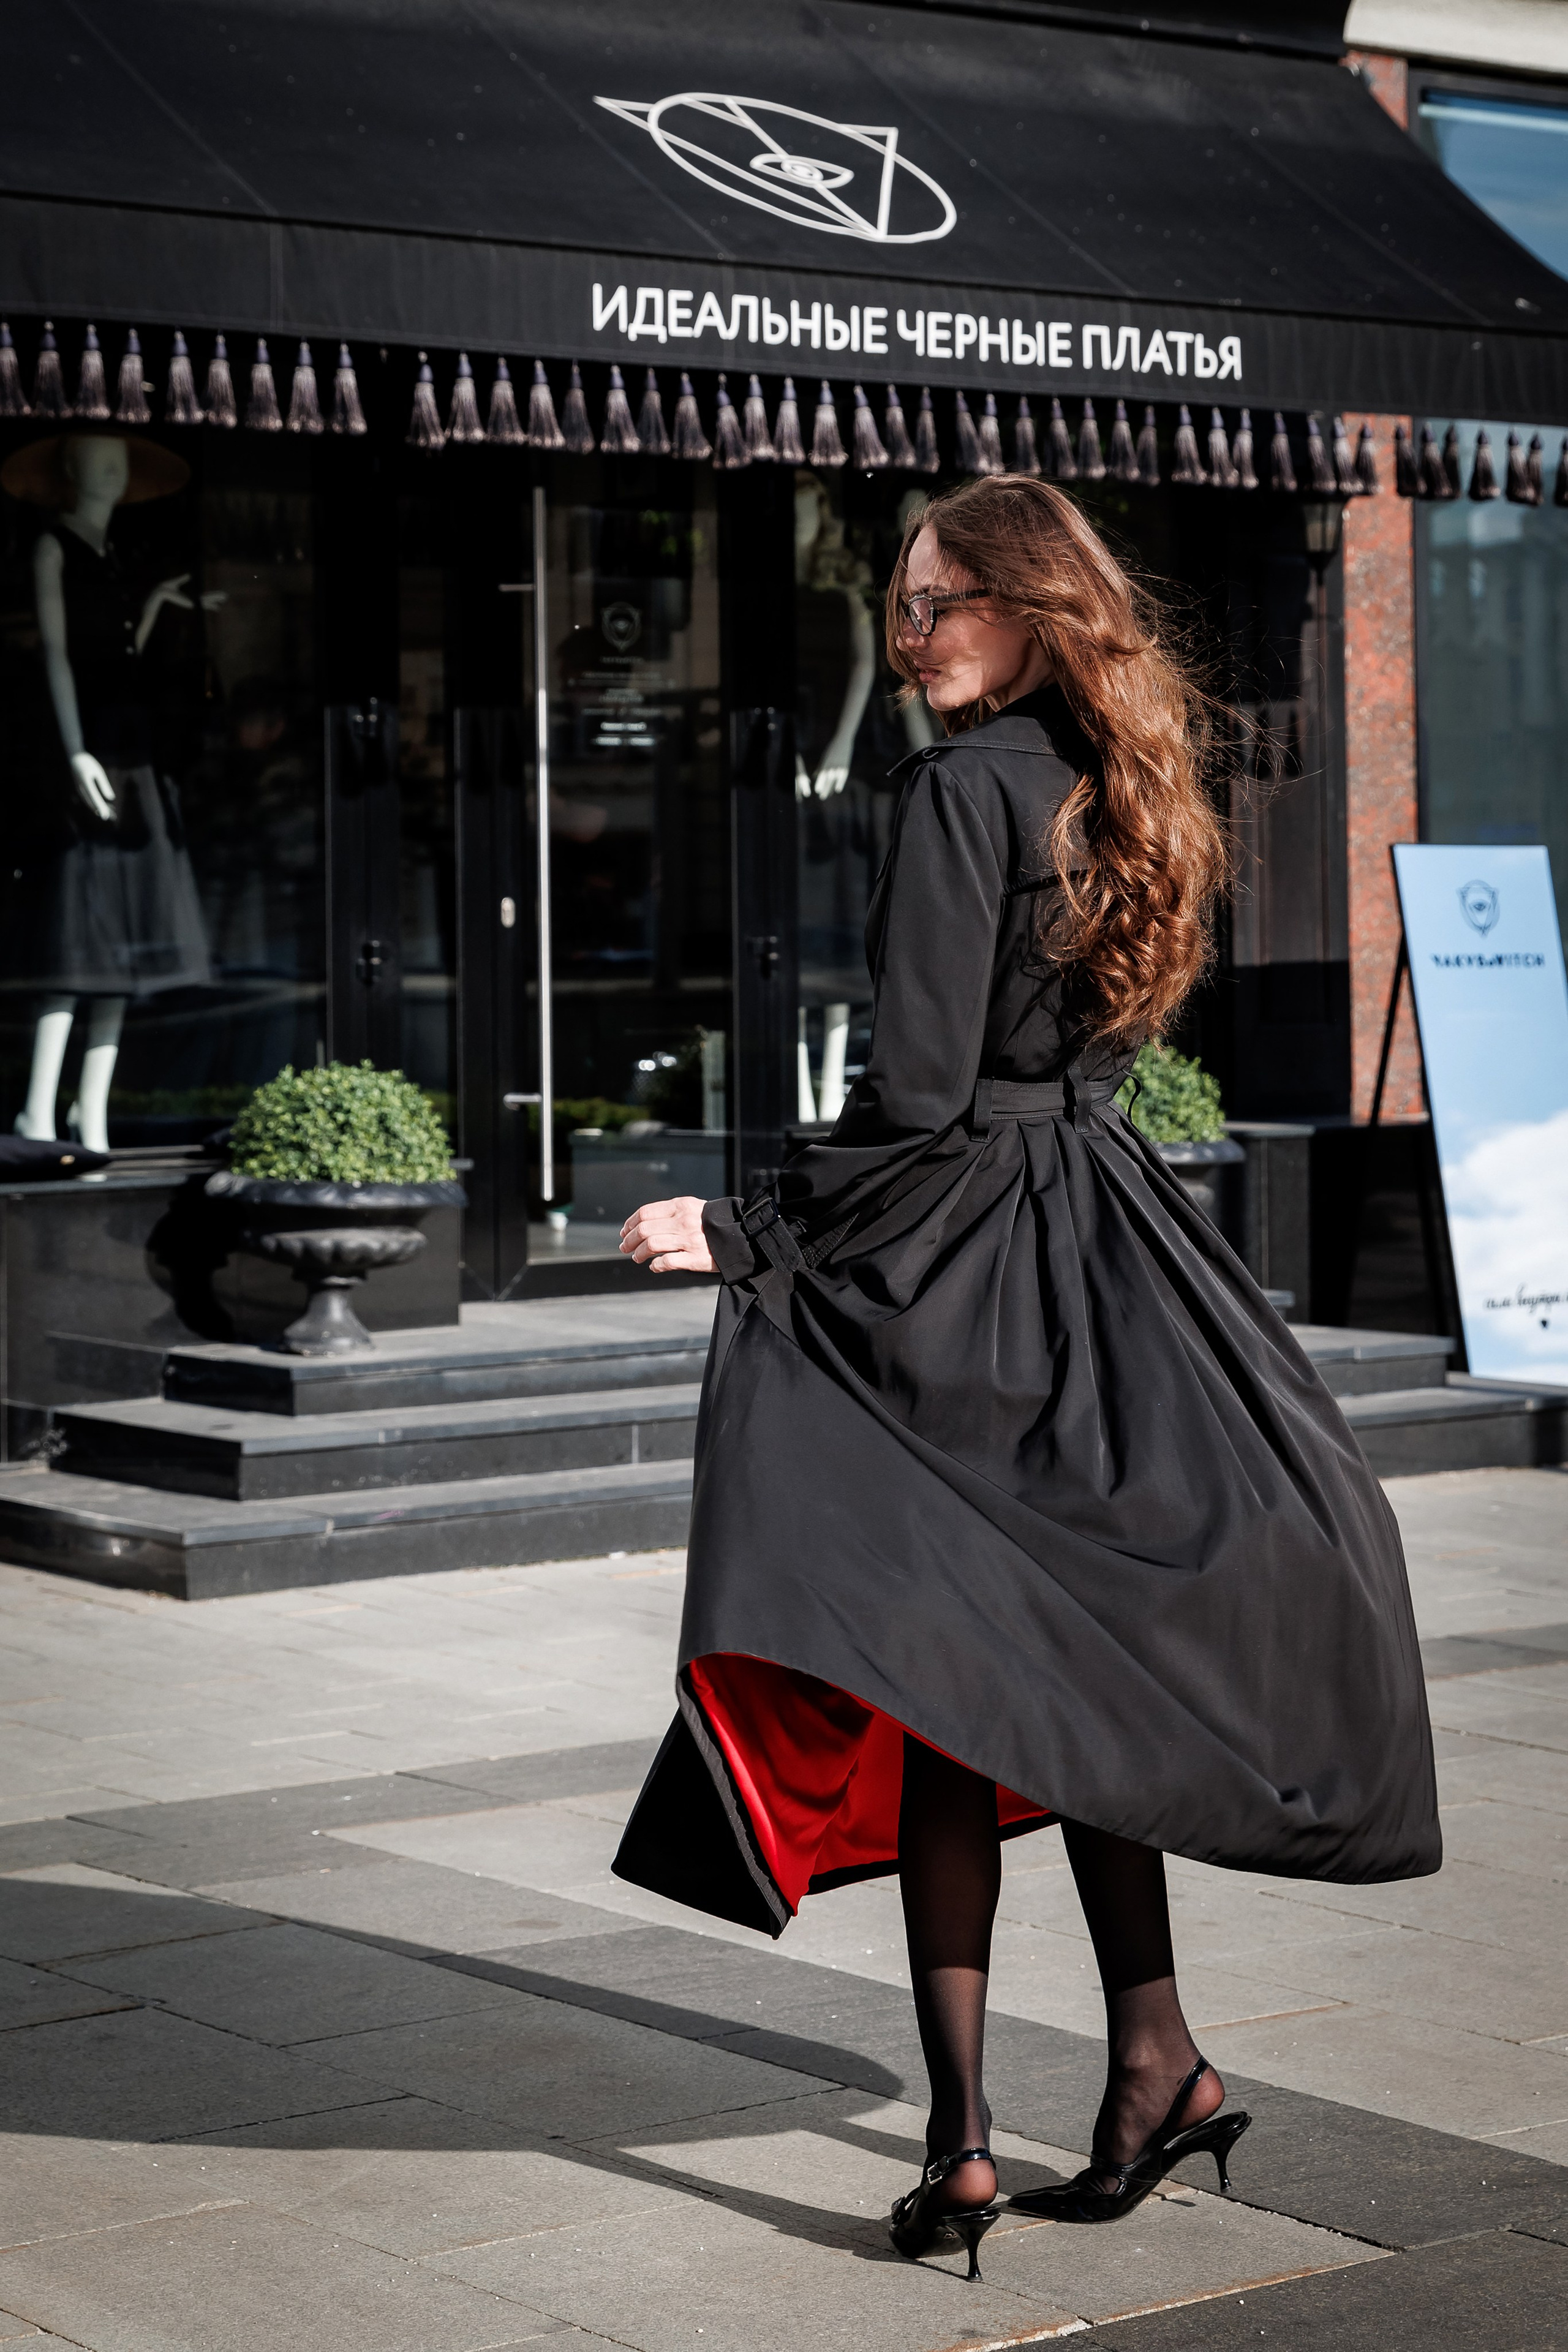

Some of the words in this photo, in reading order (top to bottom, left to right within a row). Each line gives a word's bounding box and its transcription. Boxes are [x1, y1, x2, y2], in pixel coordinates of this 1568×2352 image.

[592, 282, 889, 355] ИДЕАЛЬНЫЕ
[895, 308, 1074, 369] ЧЕРНЫЕ
[1081, 323, 1243, 381] ПЛАТЬЯ
